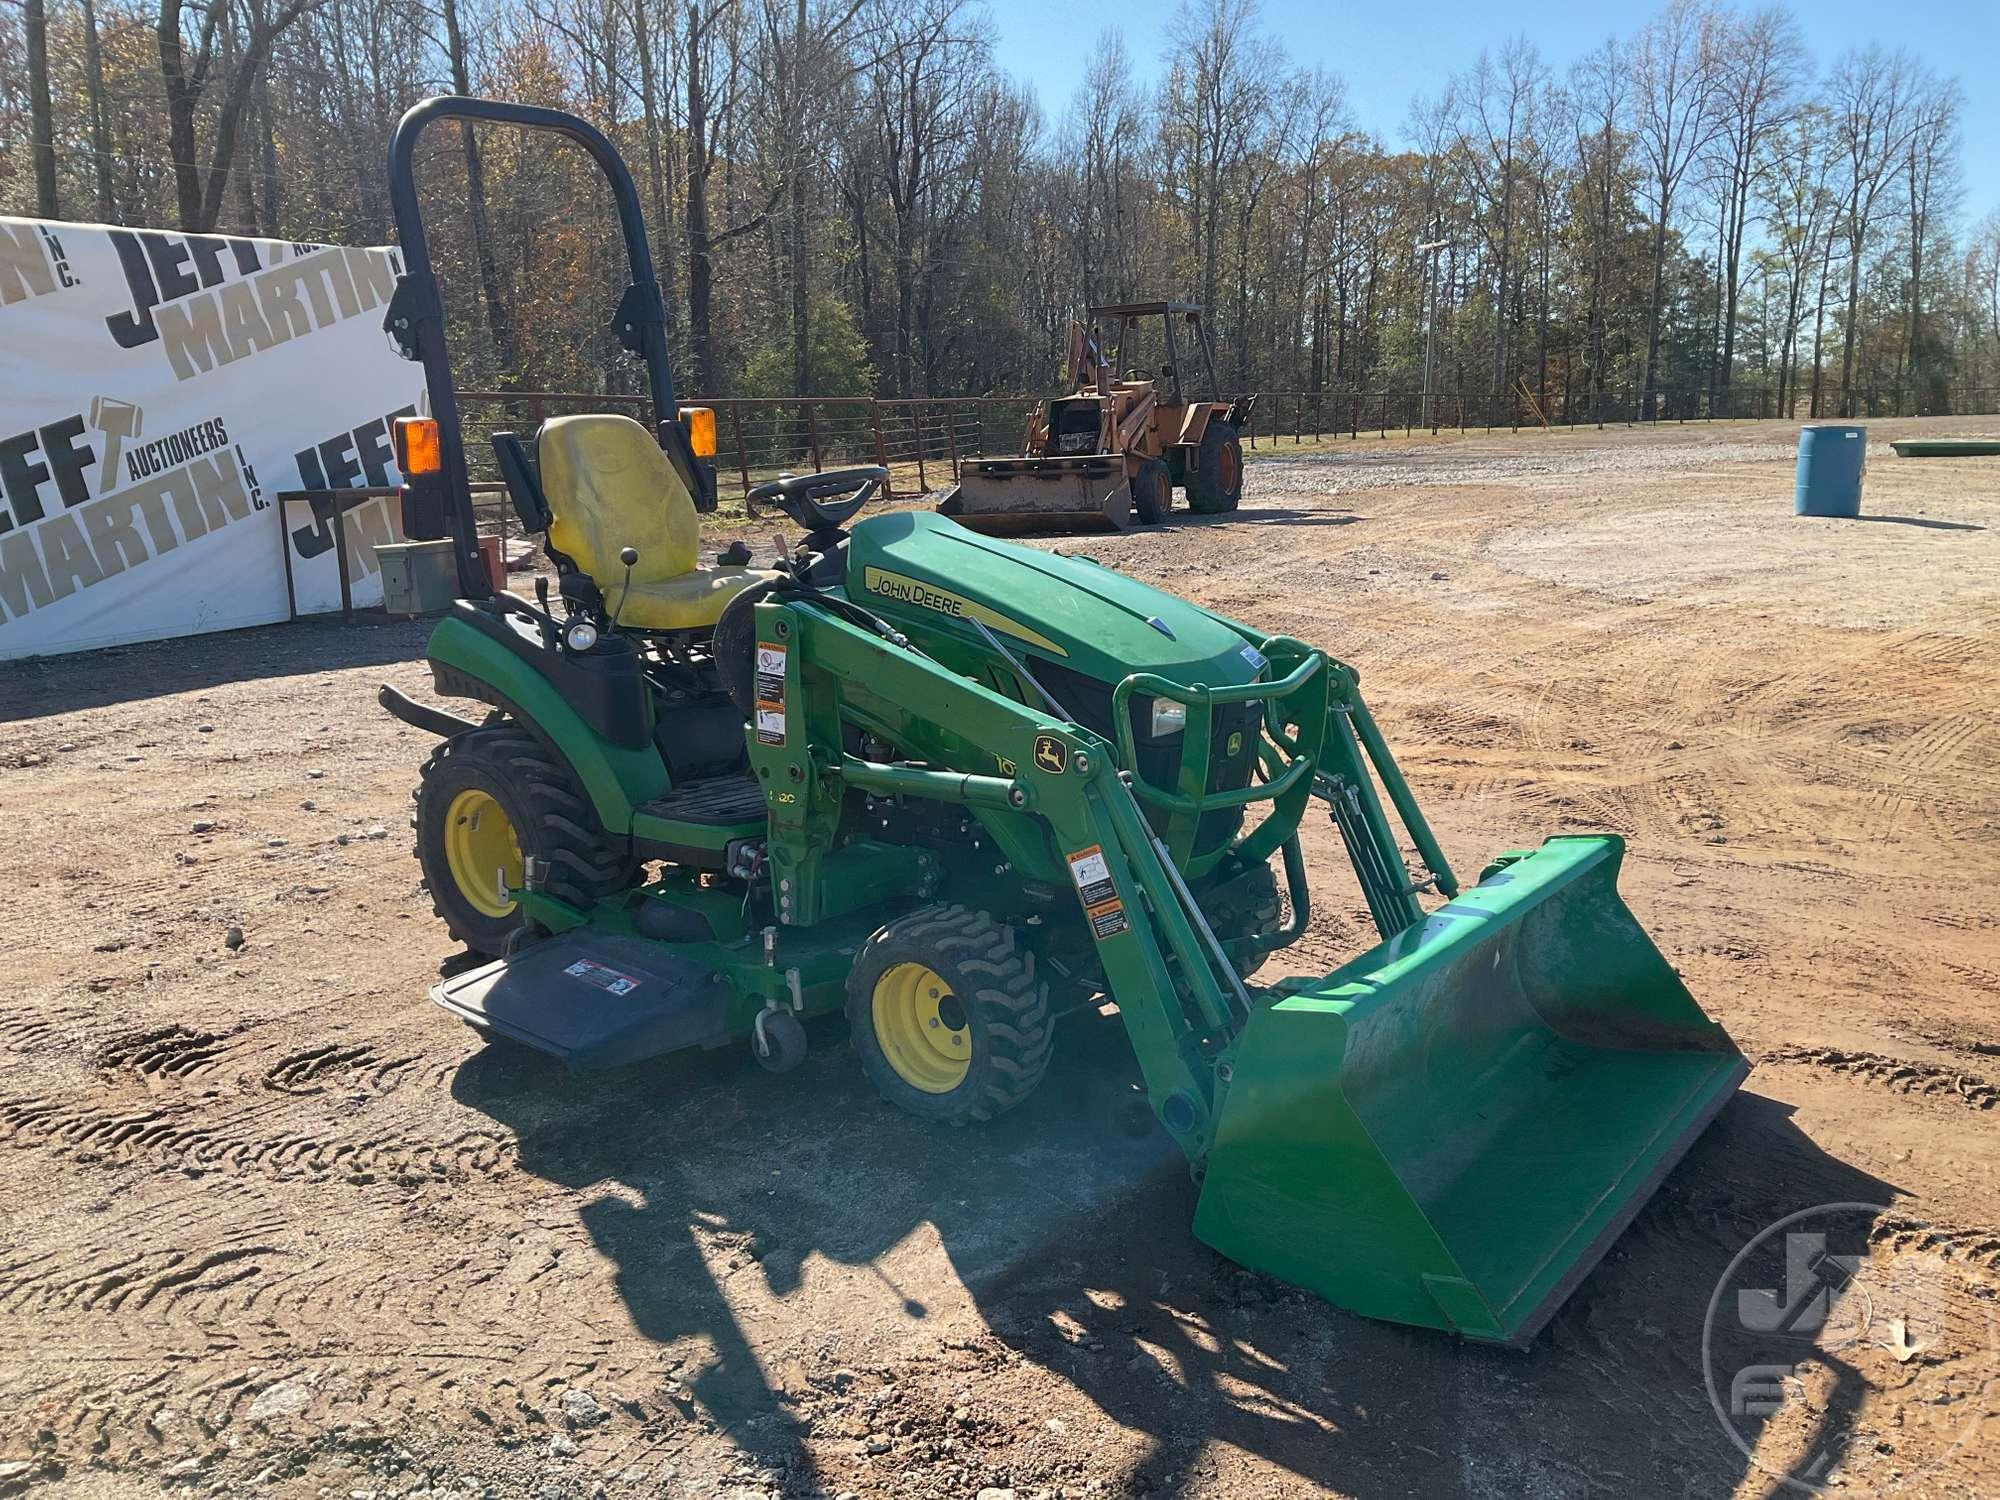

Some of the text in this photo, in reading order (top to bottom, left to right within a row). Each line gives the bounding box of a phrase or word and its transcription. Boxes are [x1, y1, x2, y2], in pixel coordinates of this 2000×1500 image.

[153, 248, 395, 382] MARTIN
[0, 413, 96, 534] FF
[126, 417, 229, 482] AUCTIONEERS
[235, 444, 271, 512] INC.
[872, 575, 962, 615] JOHN DEERE
